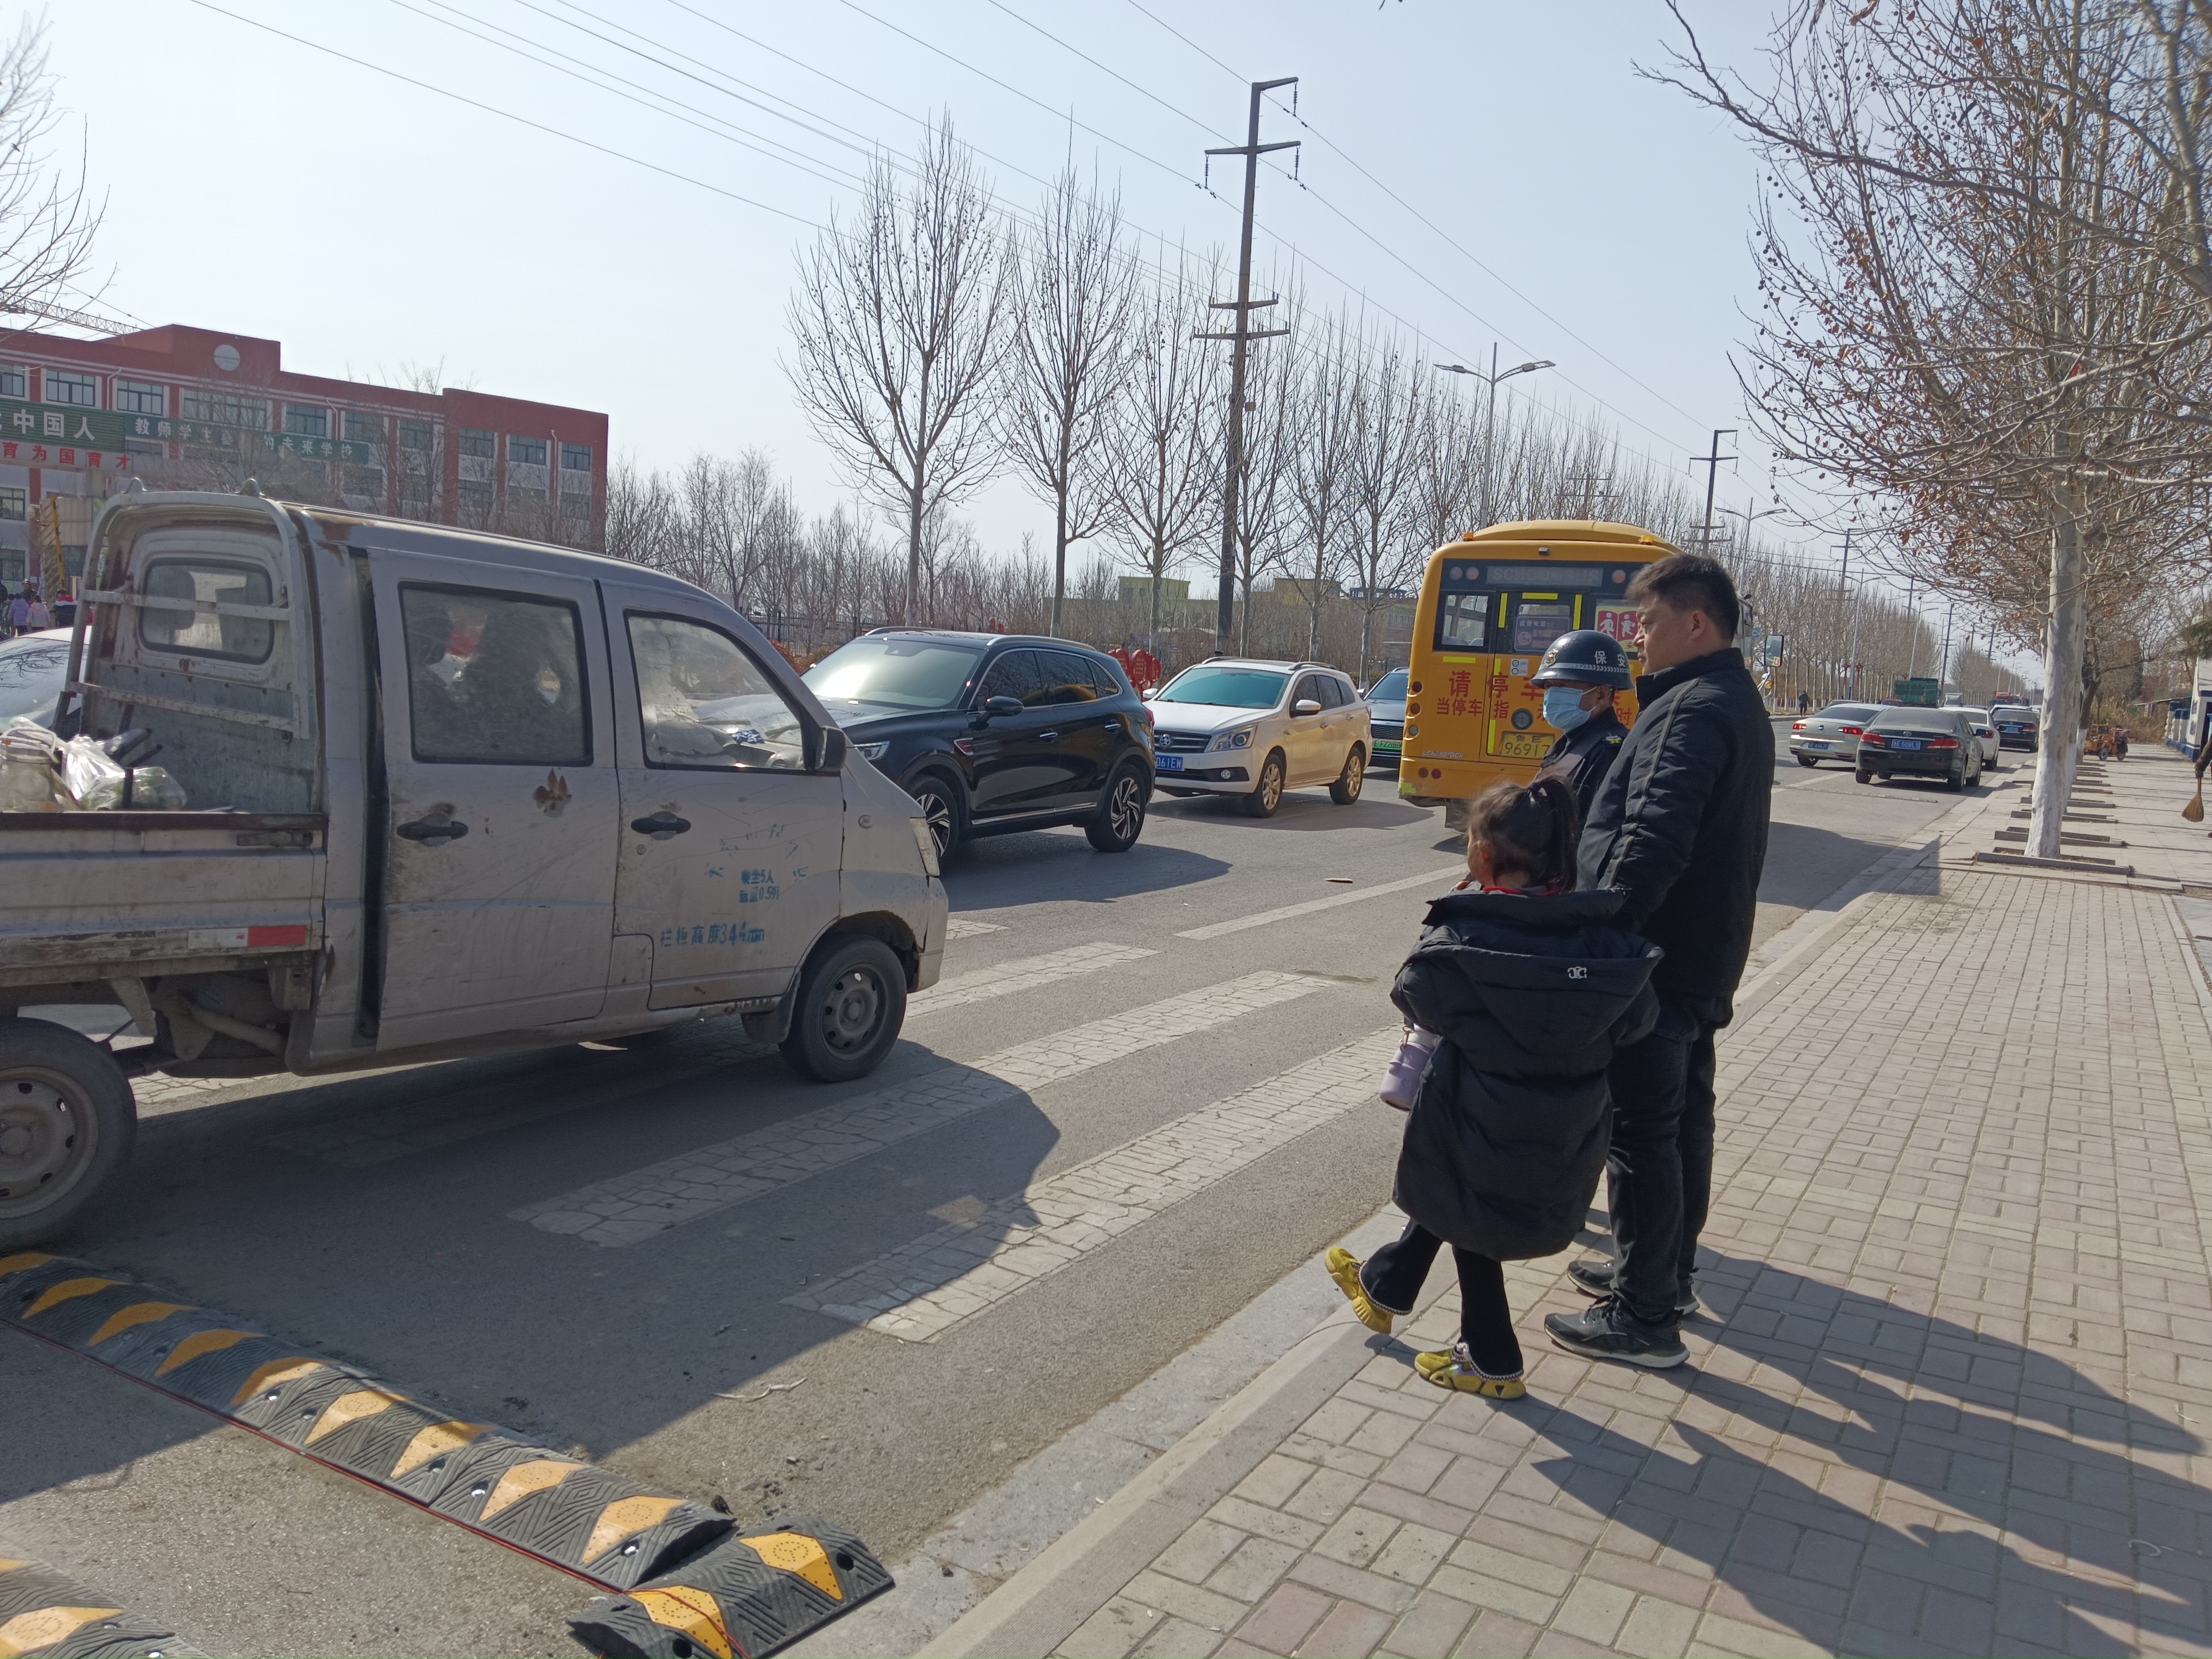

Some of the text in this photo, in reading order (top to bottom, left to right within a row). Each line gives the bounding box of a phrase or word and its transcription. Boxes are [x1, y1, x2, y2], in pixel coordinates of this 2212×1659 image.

[0, 409, 95, 441] 中国人
[135, 417, 353, 460] 教师学生喜的未来学校
[1594, 650, 1627, 668] 保安
[1505, 742, 1551, 757] 96917
